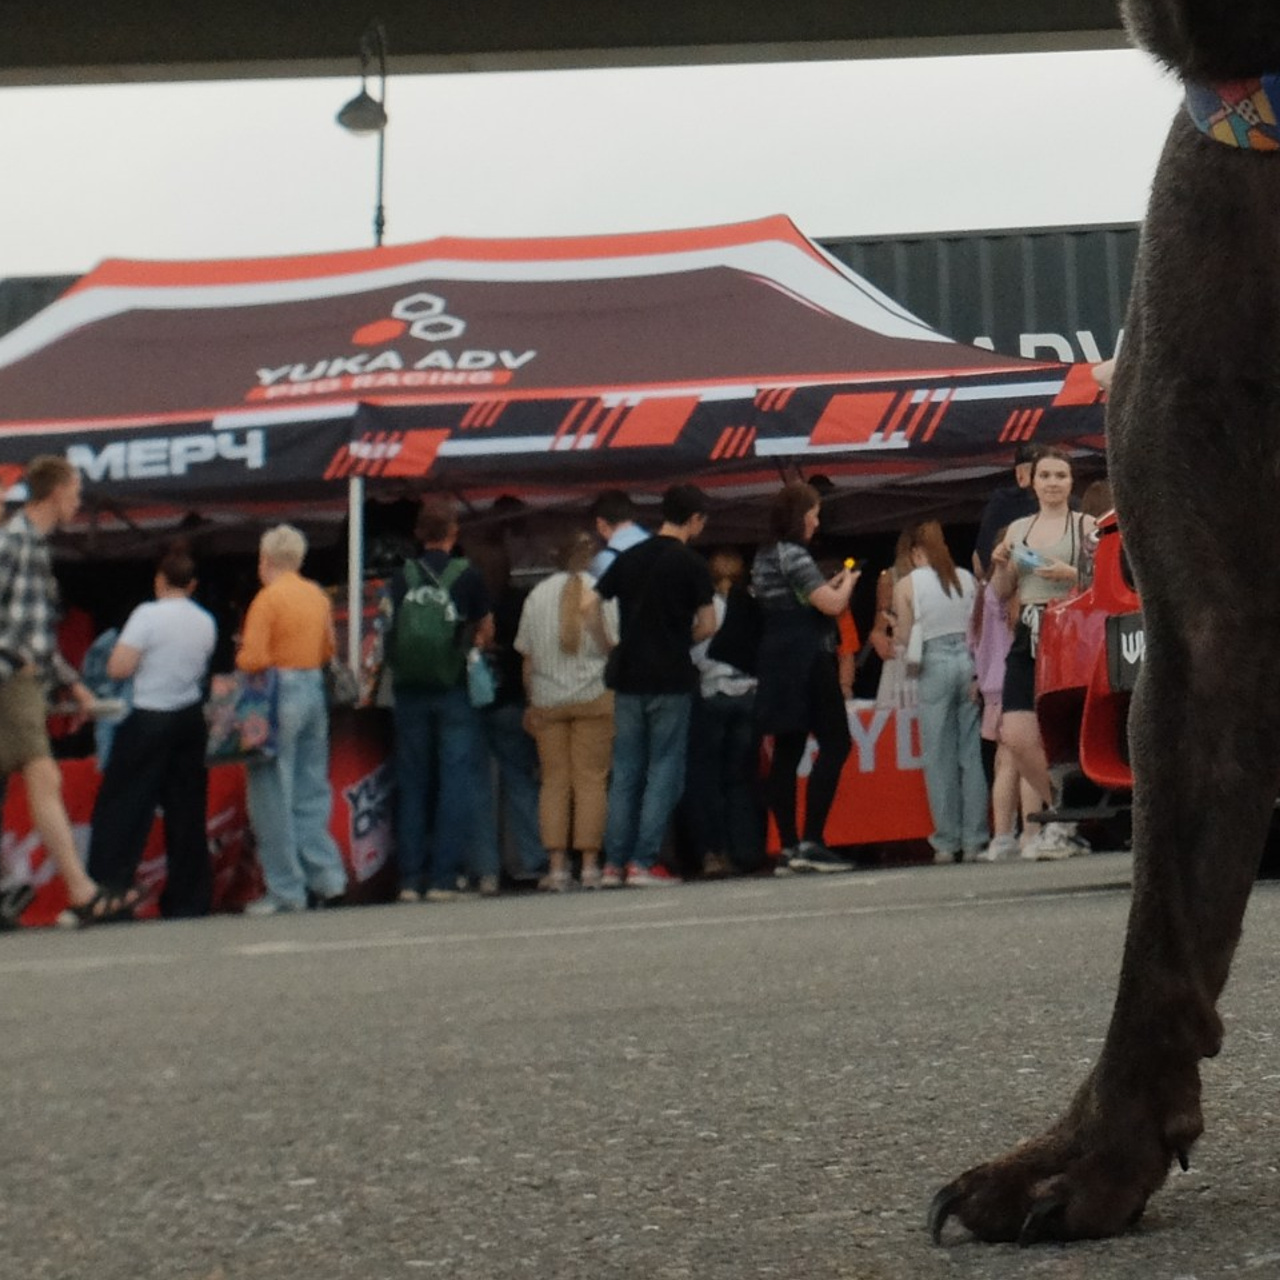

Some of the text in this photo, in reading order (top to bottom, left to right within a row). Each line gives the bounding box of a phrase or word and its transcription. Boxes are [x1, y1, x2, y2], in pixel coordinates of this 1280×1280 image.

[256, 349, 537, 386] YUKA ADV
[351, 370, 494, 390] RACING
